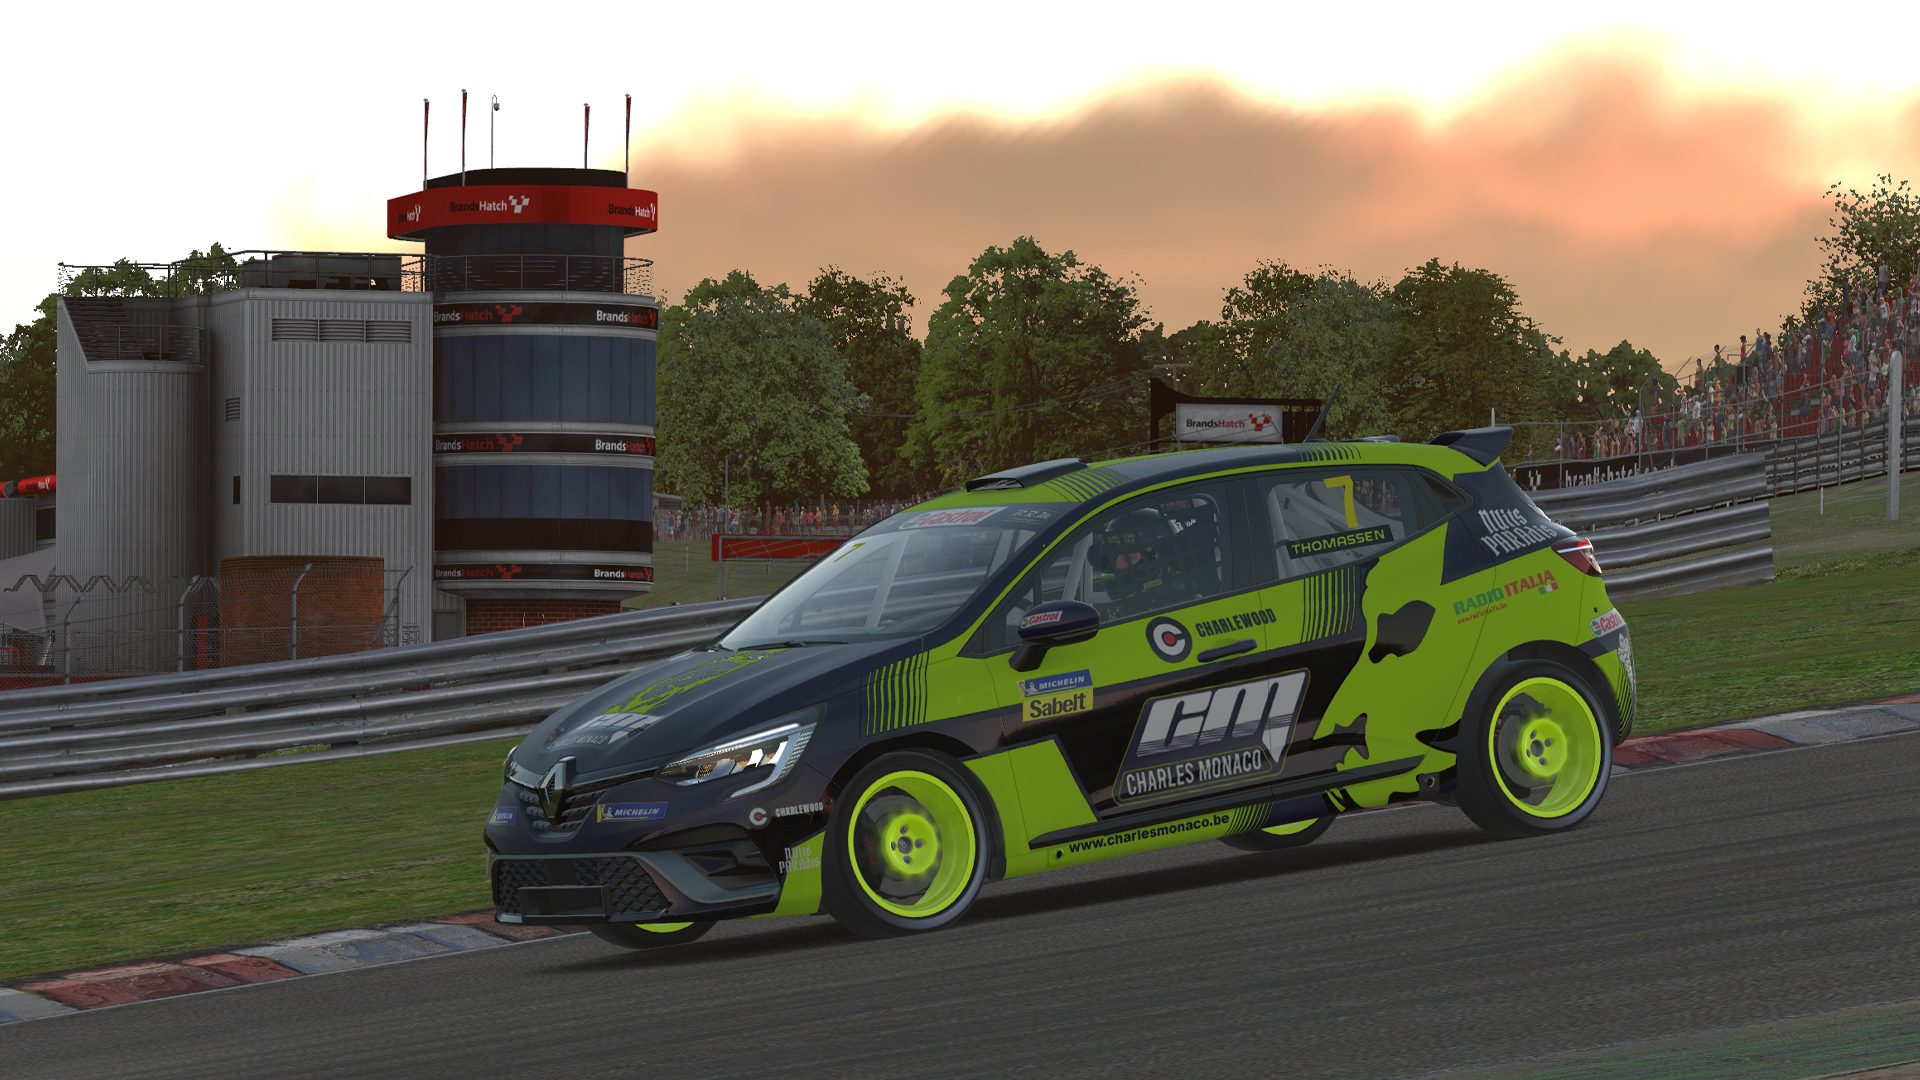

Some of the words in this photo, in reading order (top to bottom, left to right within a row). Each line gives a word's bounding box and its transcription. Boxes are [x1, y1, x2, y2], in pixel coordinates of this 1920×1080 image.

[1186, 418, 1245, 429] BrandsHatch
[1323, 475, 1358, 529] 7
[1291, 529, 1385, 554] THOMASSEN
[1452, 588, 1505, 615] RADIO
[1504, 570, 1556, 597] ITALIA
[1029, 612, 1059, 625] Castrol
[1195, 609, 1277, 637] CHARLEWOOD
[1039, 676, 1085, 690] MICHELIN
[1030, 693, 1086, 718] Sabelt
[1126, 762, 1194, 795] CHARLES
[1198, 749, 1262, 781] MONACO
[614, 807, 660, 816] MICHELIN
[775, 802, 824, 817] CHARLEWOOD
[1068, 814, 1230, 853] www.charlesmonaco.be
